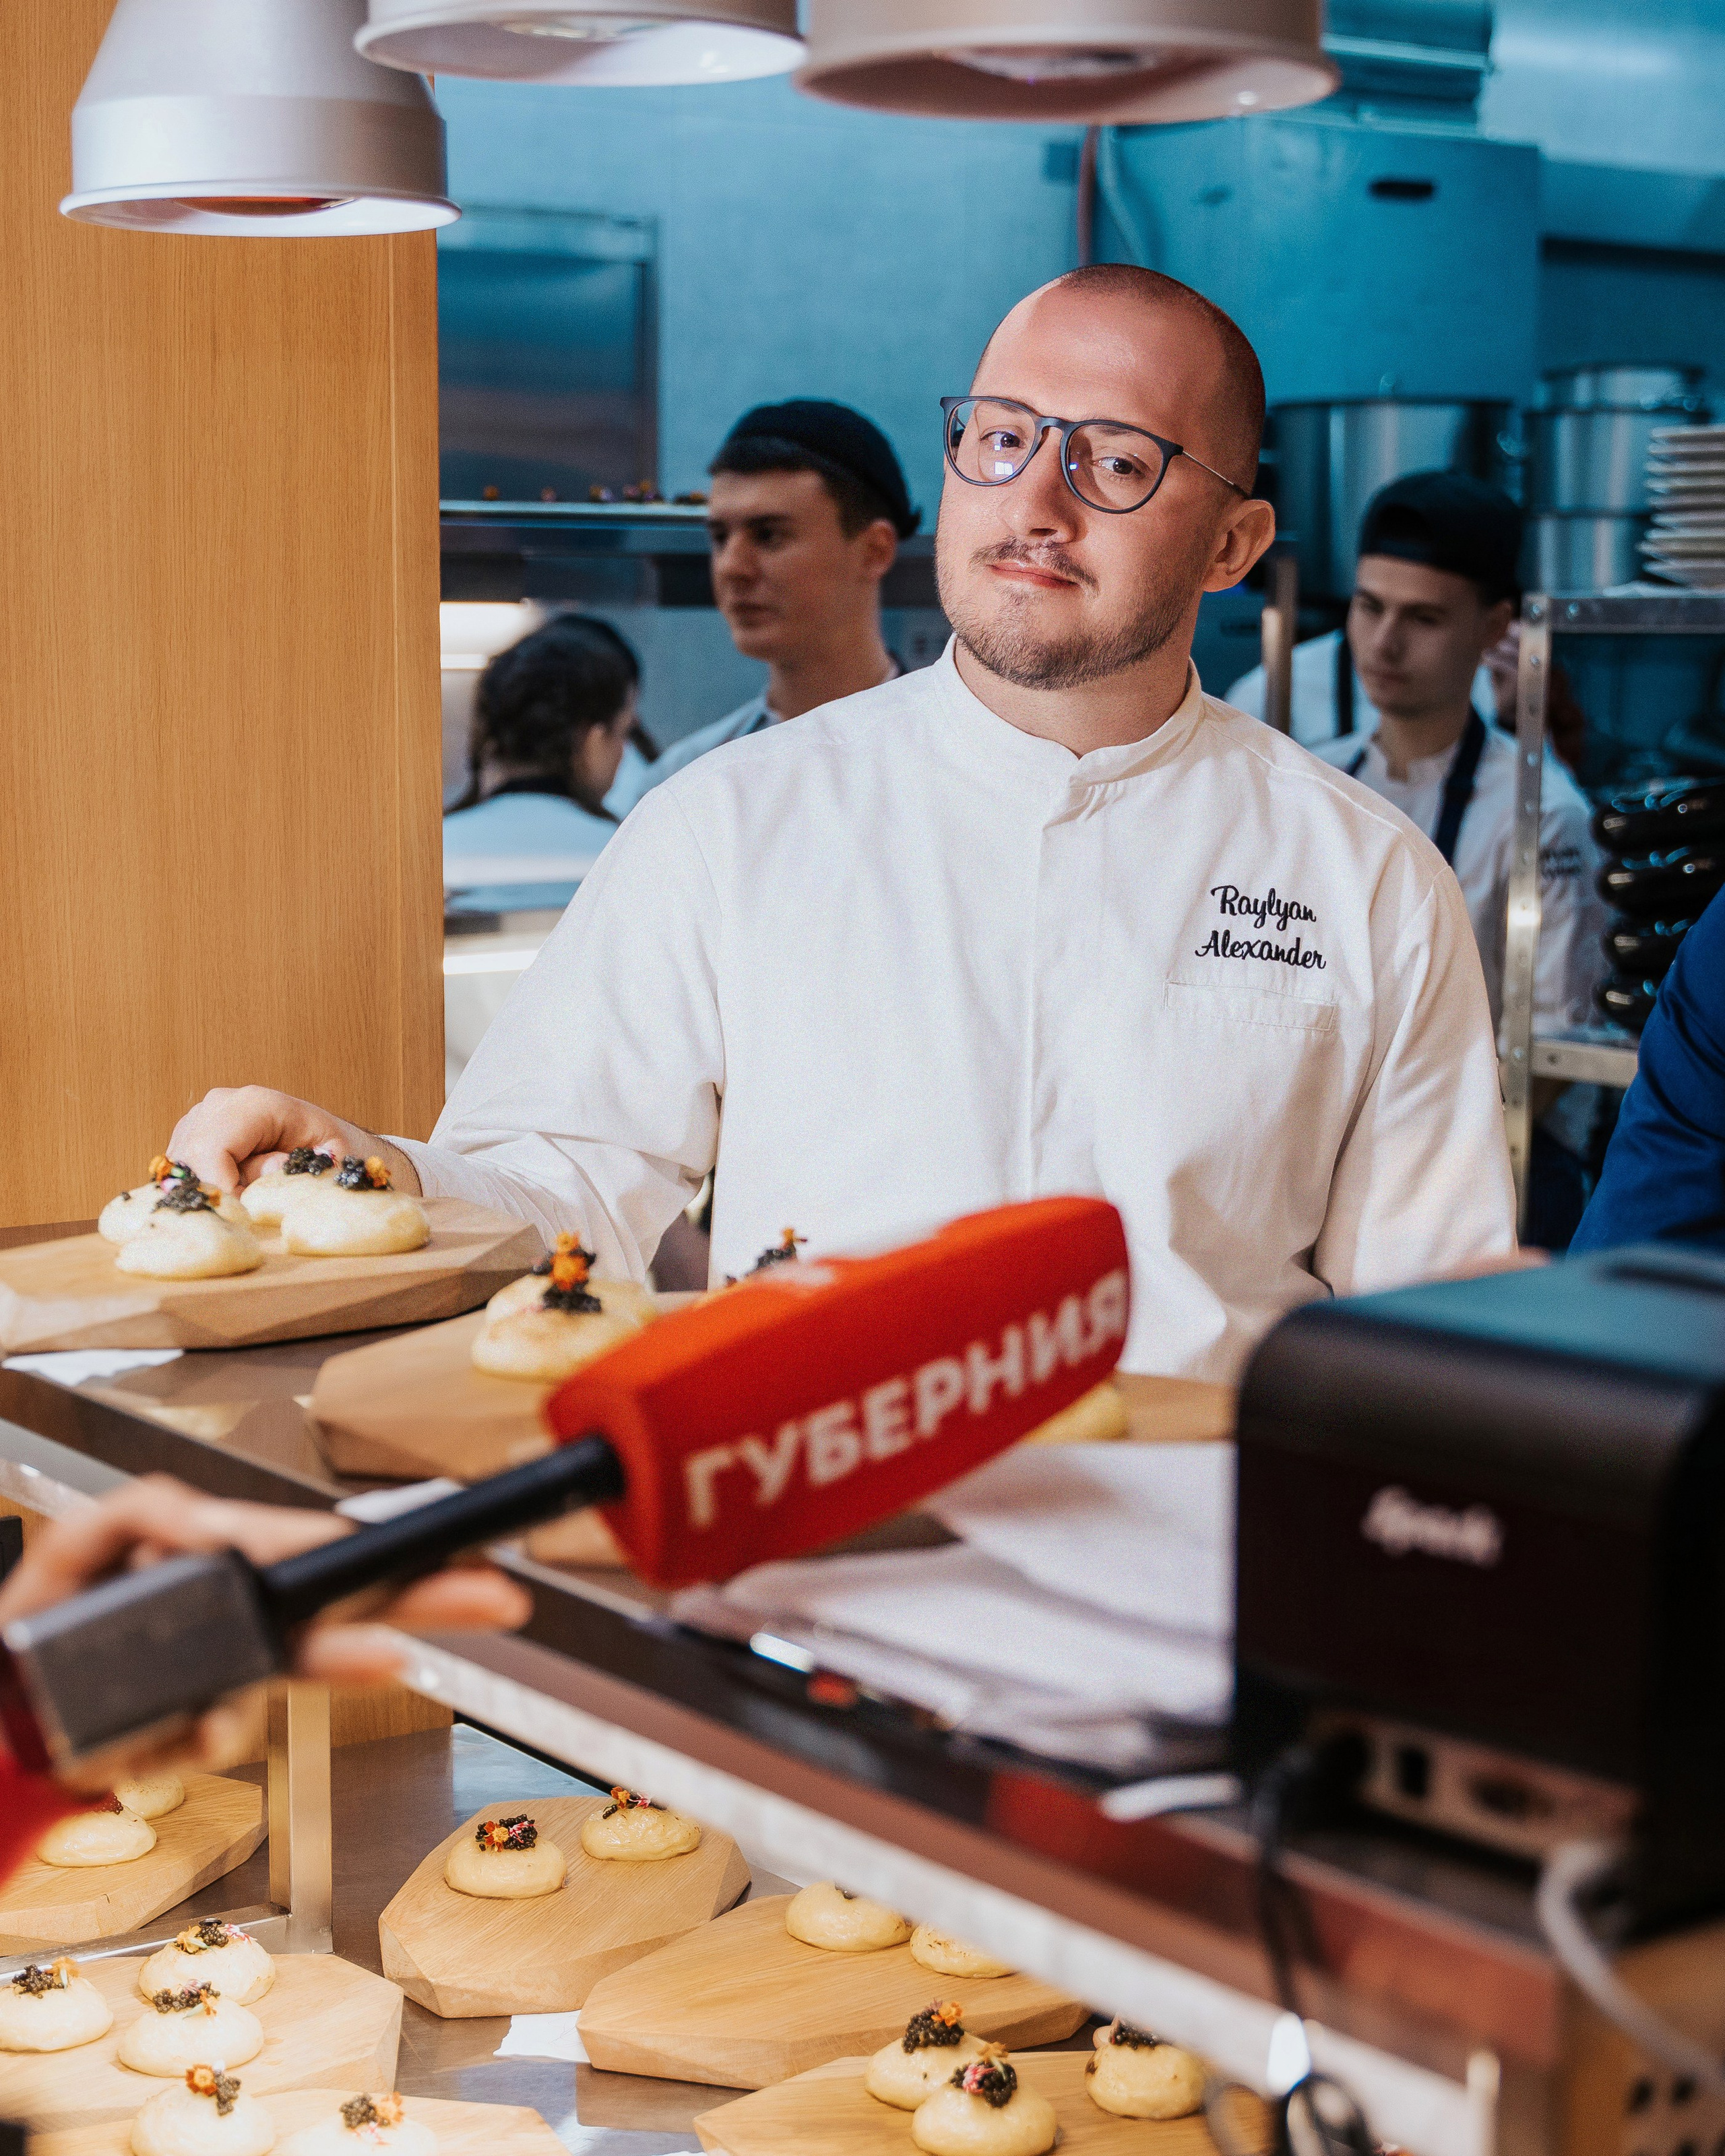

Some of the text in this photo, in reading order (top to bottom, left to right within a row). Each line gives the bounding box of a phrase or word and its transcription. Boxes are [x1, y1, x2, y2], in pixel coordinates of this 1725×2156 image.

[1210, 885, 1317, 931] Raylyan
[1195, 929, 1326, 969] Alexander
[687, 1271, 1128, 1524] ГУБЕРНИЯ
